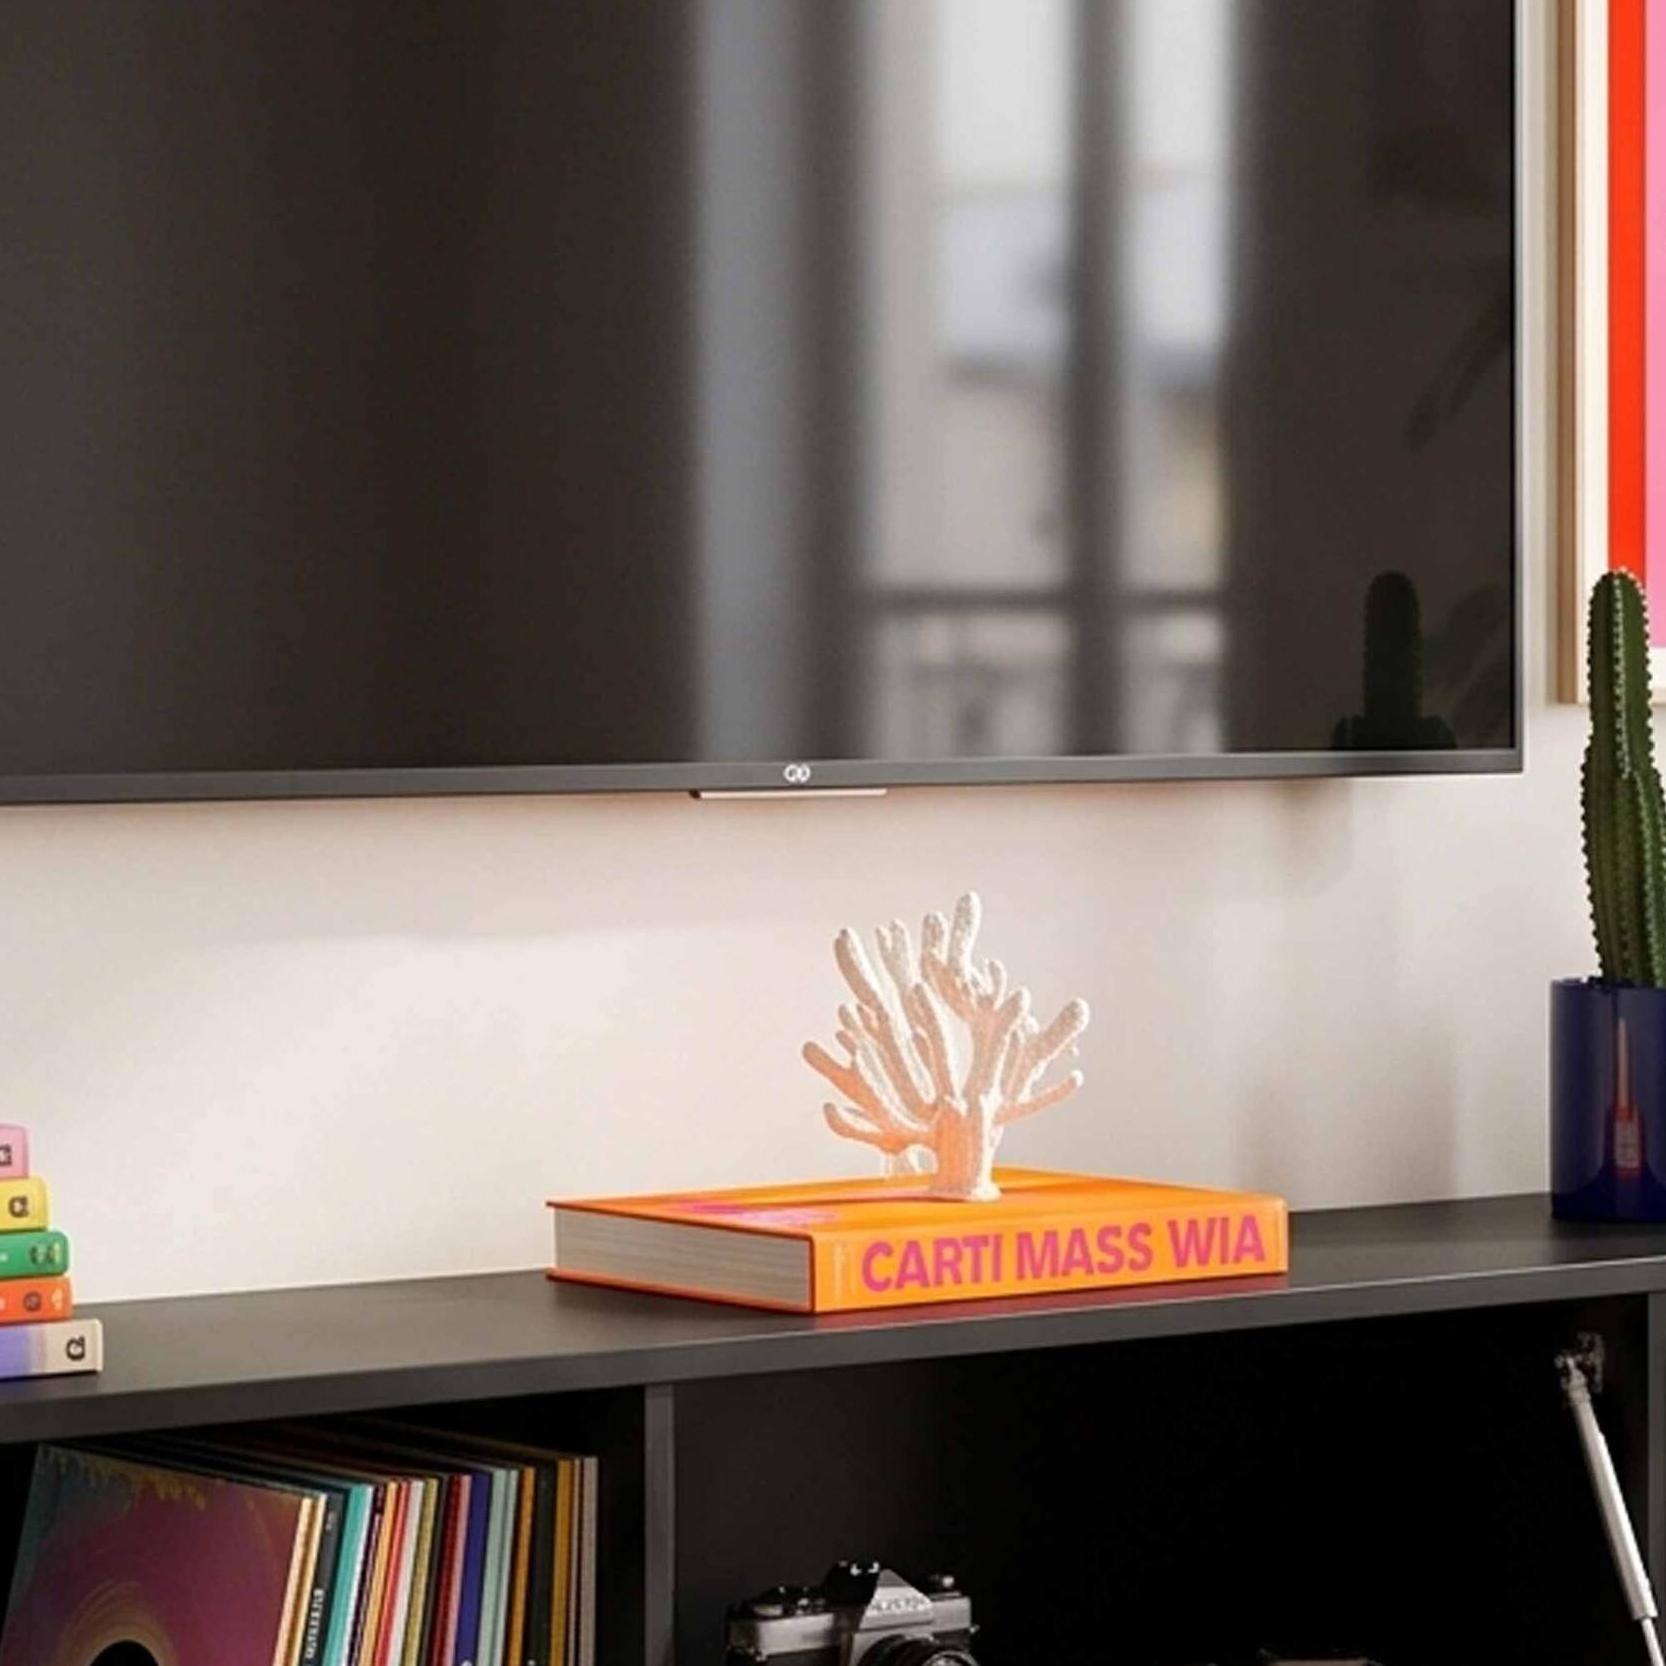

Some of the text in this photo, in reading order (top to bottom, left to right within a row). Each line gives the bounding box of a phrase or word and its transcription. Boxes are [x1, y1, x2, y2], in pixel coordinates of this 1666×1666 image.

[862, 1215, 1266, 1293] CARTI MASS WIA
